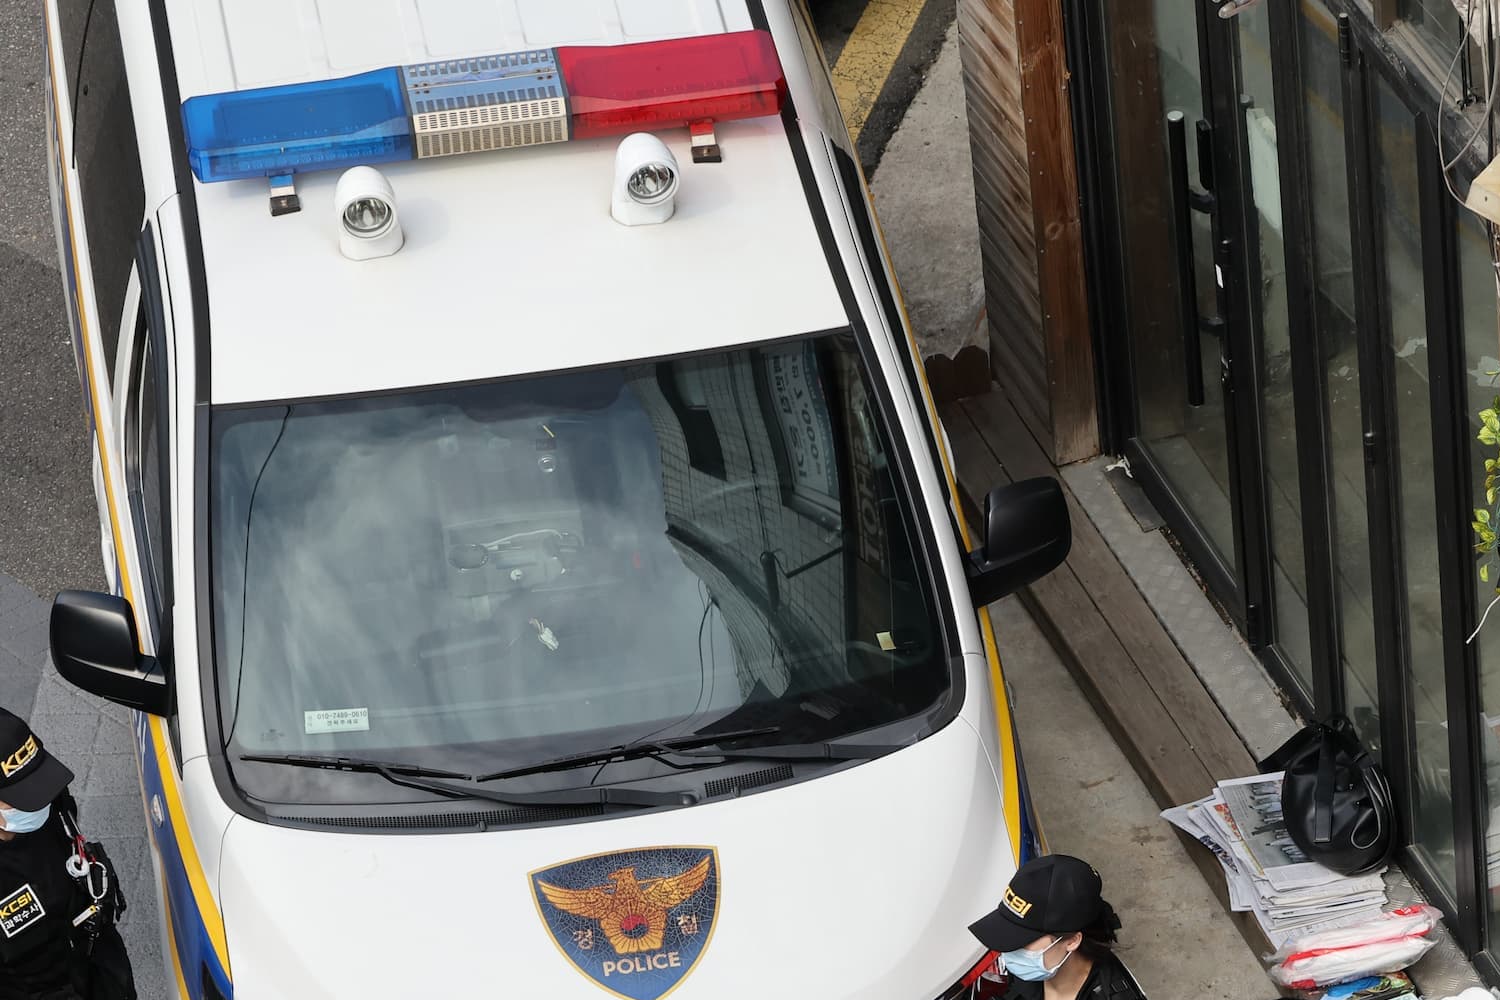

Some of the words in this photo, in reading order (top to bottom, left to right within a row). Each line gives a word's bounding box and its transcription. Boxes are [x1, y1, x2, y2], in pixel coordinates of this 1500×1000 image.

[1, 735, 38, 774] KCS
[0, 891, 32, 918] KCSI
[4, 903, 39, 930] 과학수사
[602, 951, 681, 976] POLICE
